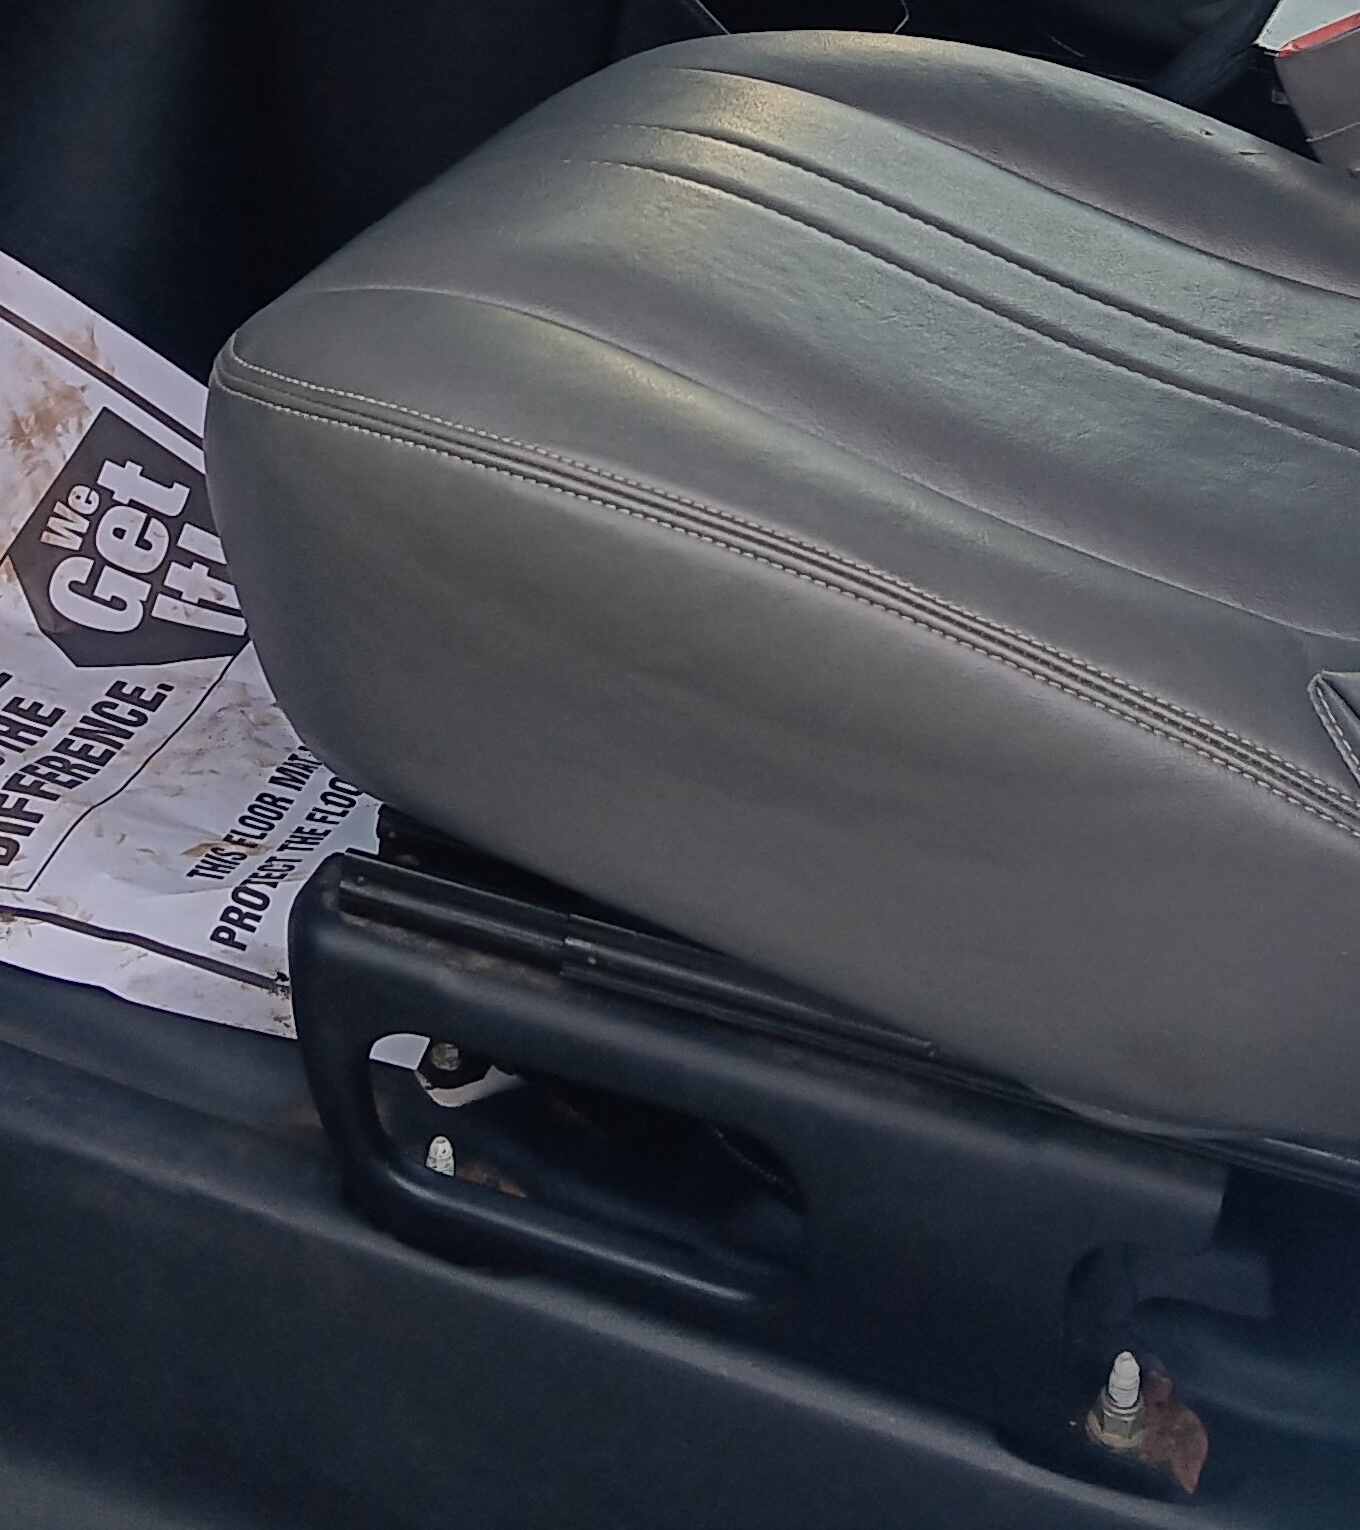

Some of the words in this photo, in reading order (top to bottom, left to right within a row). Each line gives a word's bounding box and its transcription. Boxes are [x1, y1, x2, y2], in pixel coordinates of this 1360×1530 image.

[40, 484, 101, 551] We
[48, 459, 191, 633] Get
[186, 846, 249, 880] THIS
[222, 791, 296, 849] FLOOR
[268, 753, 323, 792] MAT
[209, 856, 304, 952] PROTECT
[275, 826, 333, 852] THE
